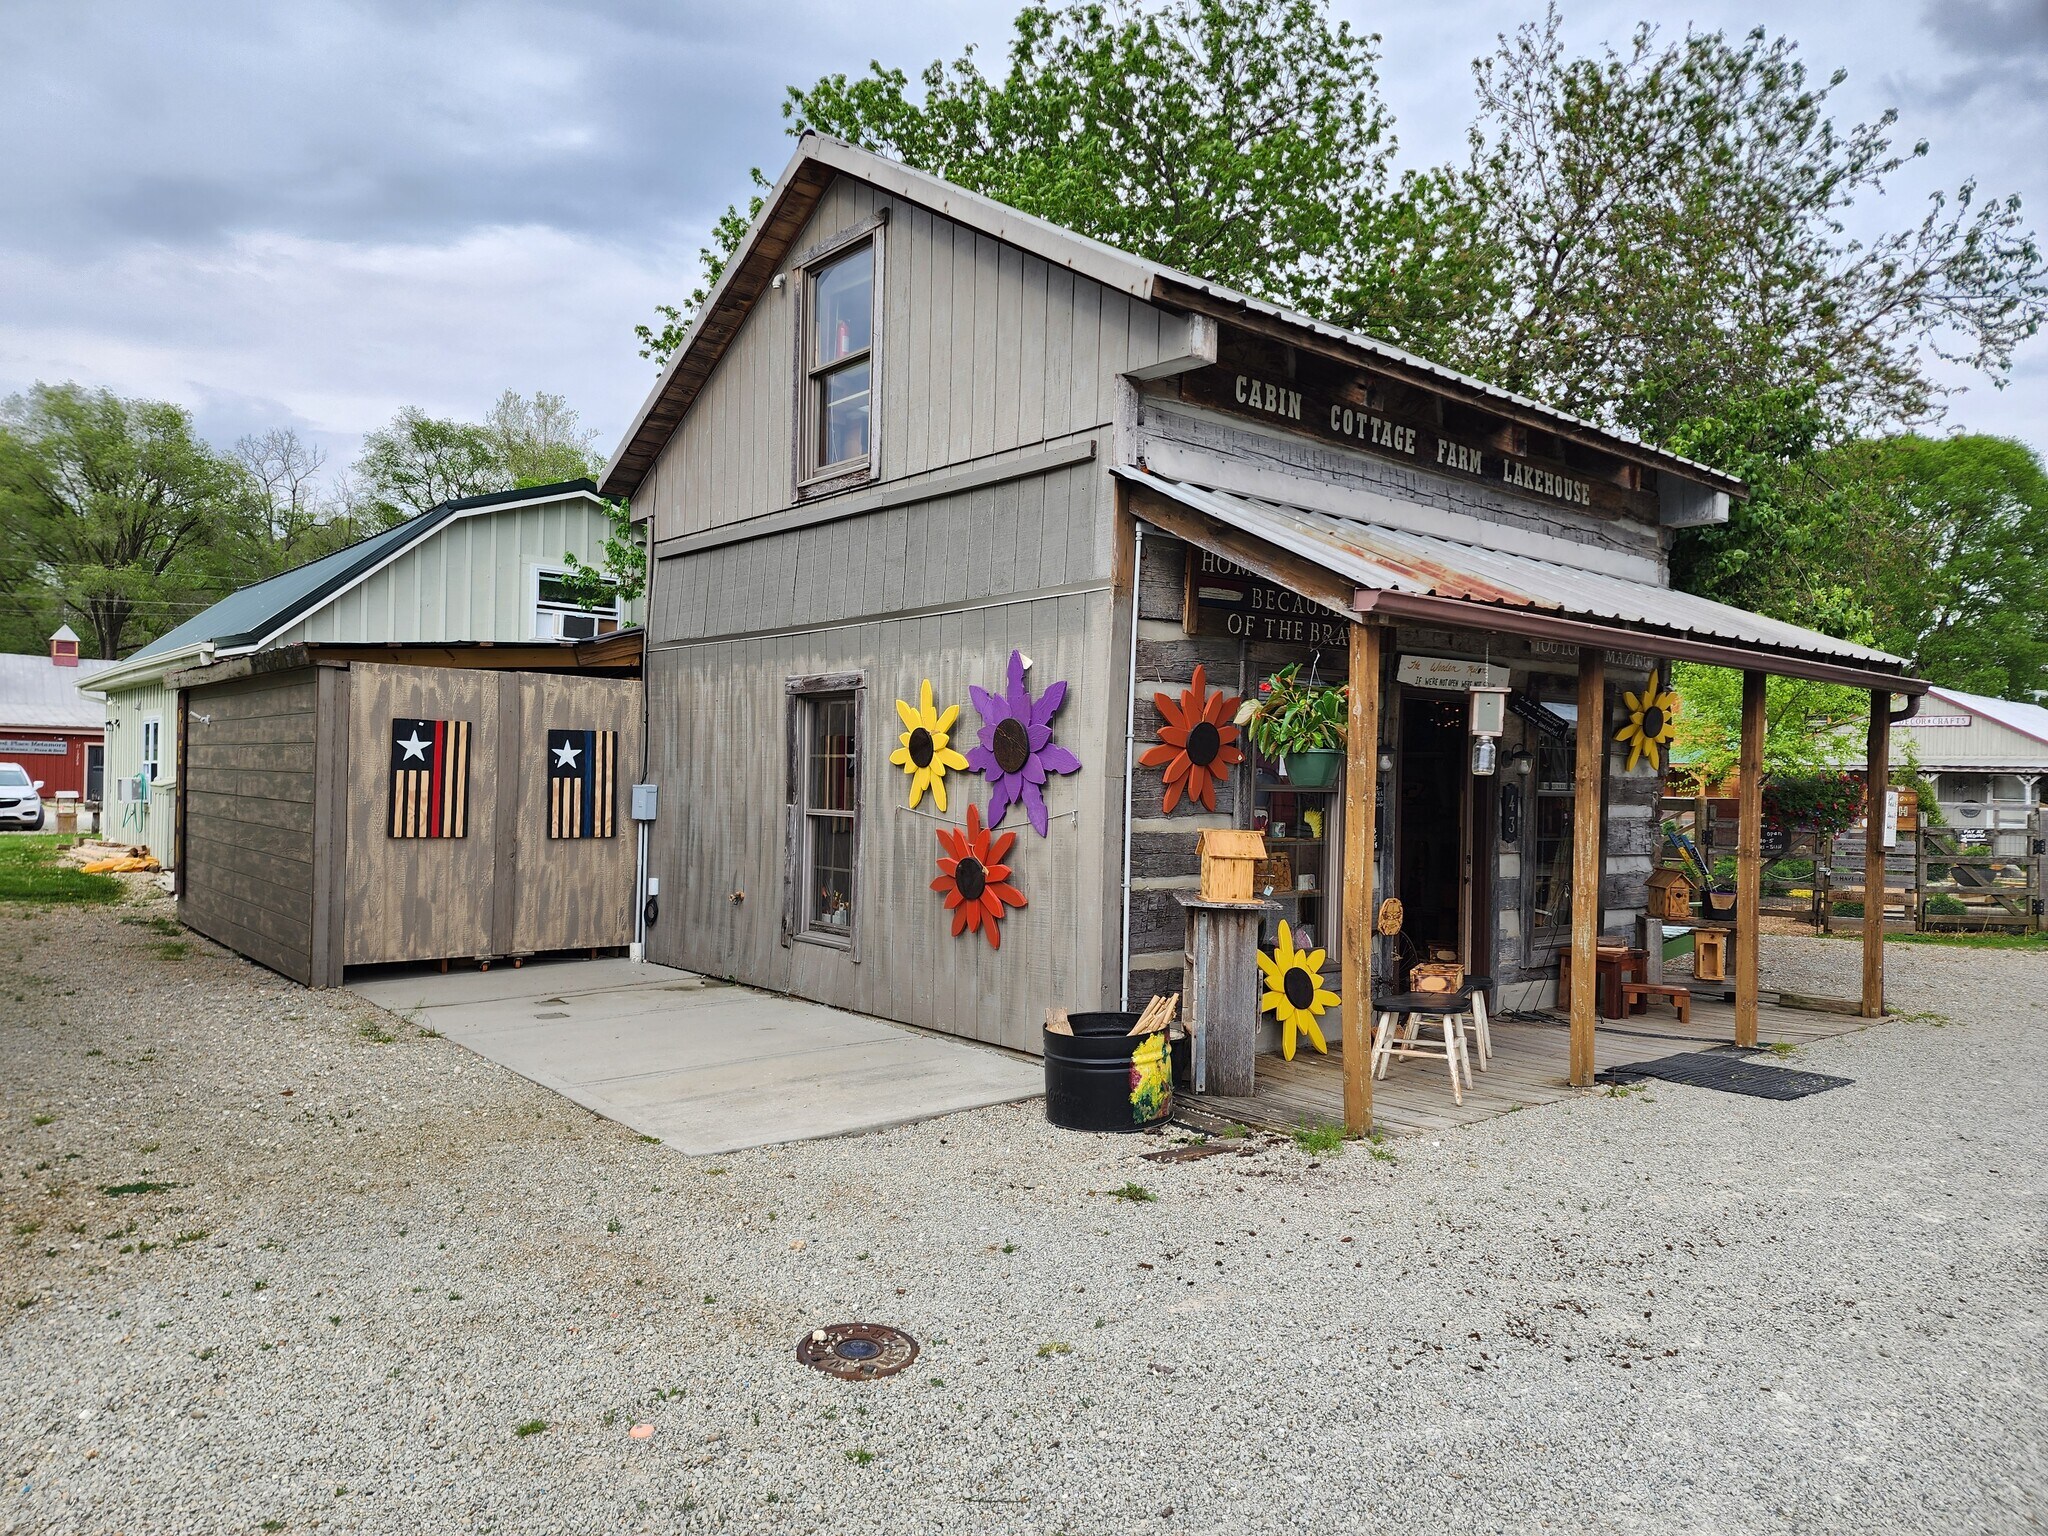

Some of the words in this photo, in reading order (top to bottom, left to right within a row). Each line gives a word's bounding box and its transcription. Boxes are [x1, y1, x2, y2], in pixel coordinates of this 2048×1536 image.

[1235, 374, 1301, 420] CABIN
[1330, 404, 1416, 456] COTTAGE
[1436, 438, 1482, 475] FARM
[1503, 459, 1590, 506] LAKEHOUSE
[1201, 550, 1262, 578] HO
[1251, 587, 1342, 618] BECAUS
[1227, 613, 1256, 636] OF
[1264, 617, 1304, 641] THE
[1309, 622, 1350, 646] BRA
[1561, 644, 1580, 656] LO
[1604, 650, 1654, 669] MAZING
[1407, 660, 1421, 671] The
[1932, 717, 1966, 725] CRAFTS
